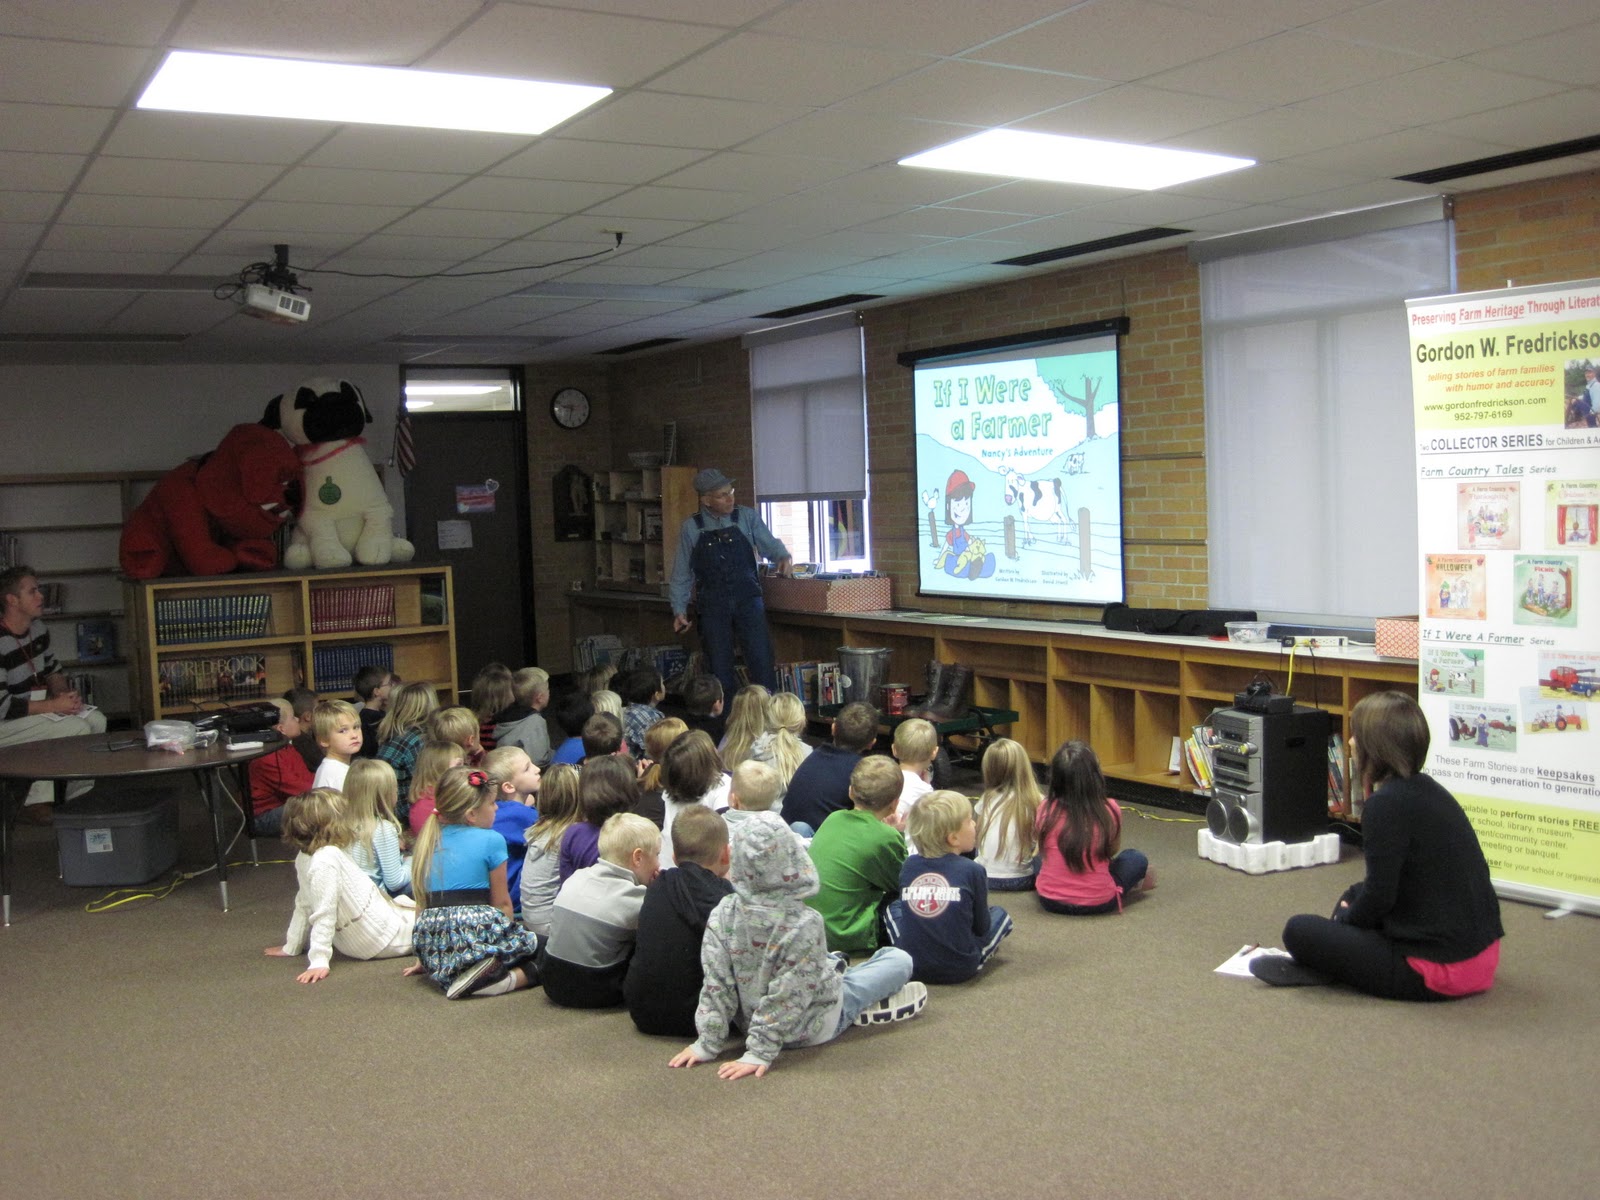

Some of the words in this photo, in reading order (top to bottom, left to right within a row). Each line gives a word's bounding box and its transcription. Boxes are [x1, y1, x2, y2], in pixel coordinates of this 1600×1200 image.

[1412, 311, 1456, 326] Preserving
[1459, 308, 1482, 321] Farm
[1485, 303, 1525, 320] Heritage
[1527, 297, 1565, 315] Through
[1416, 341, 1475, 363] Gordon
[1480, 337, 1500, 357] W.
[1506, 330, 1600, 356] Fredrickso
[1428, 370, 1452, 383] telling
[1455, 369, 1484, 380] stories
[1487, 367, 1496, 377] of
[1497, 366, 1517, 377] farm
[1520, 364, 1555, 375] families
[934, 378, 951, 408] If
[958, 377, 968, 406] I
[975, 374, 1032, 405] Were
[1445, 382, 1463, 393] with
[1466, 380, 1493, 391] humor
[1496, 379, 1513, 389] and
[1515, 378, 1555, 389] accuracy
[1424, 396, 1546, 412] www.gordonfredrickson.com
[1454, 410, 1513, 421] 952-797-6169
[951, 418, 965, 440] a
[971, 411, 1052, 440] Farmer
[1431, 435, 1498, 451] COLLECTOR
[1501, 433, 1543, 448] SERIES
[1545, 437, 1555, 446] for
[1556, 436, 1585, 446] Children
[1586, 436, 1592, 445] &
[981, 448, 1012, 461] Nancy's
[1013, 447, 1053, 458] Adventure
[1421, 466, 1443, 477] Farm
[1448, 465, 1490, 478] Country
[1496, 464, 1524, 475] Tales
[1529, 465, 1557, 474] Series
[1423, 629, 1431, 639] If
[1435, 630, 1441, 639] I
[1446, 631, 1472, 641] Were
[1477, 632, 1484, 641] A
[1488, 633, 1525, 644] Farmer
[1529, 637, 1555, 646] Series
[218, 655, 266, 674] BOOK
[1435, 755, 1461, 766] These
[1463, 757, 1485, 769] Farm
[1487, 761, 1517, 773] Stories
[1520, 766, 1534, 775] are
[1537, 766, 1595, 783] keepsakes
[1432, 768, 1452, 778] pass
[1466, 771, 1488, 782] from
[1490, 774, 1540, 790] generation
[1542, 781, 1552, 790] to
[1554, 784, 1600, 797] generatio
[1463, 804, 1488, 815] ailable
[1490, 808, 1498, 816] to
[1500, 810, 1535, 822] perform
[1538, 815, 1570, 826] stories
[1572, 819, 1600, 831] FREE
[1481, 841, 1512, 854] meeting
[1514, 846, 1523, 854] or
[1503, 860, 1513, 868] for
[1515, 863, 1529, 872] your
[1532, 866, 1555, 876] school
[1556, 870, 1564, 878] or
